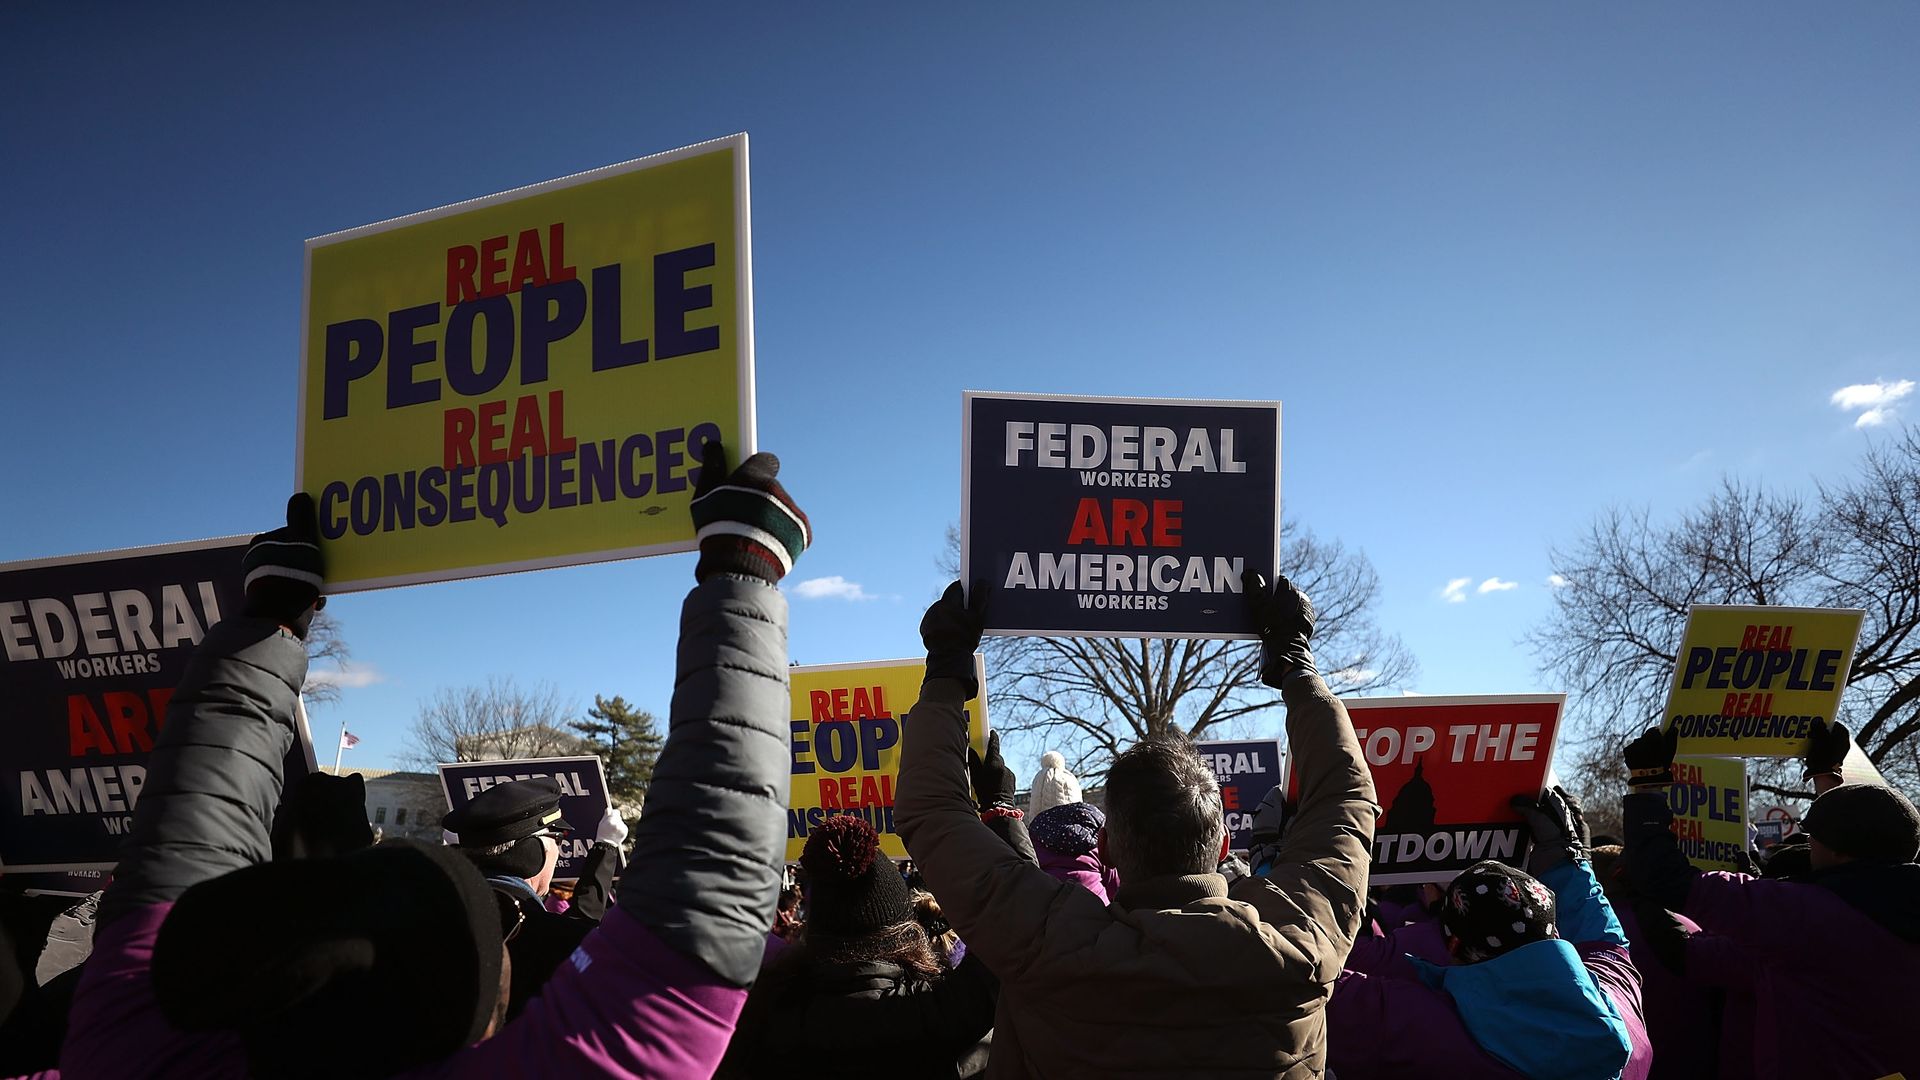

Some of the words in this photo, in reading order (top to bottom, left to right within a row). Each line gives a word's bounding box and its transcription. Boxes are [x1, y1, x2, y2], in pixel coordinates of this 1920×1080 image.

[447, 222, 577, 307] REAL
[323, 242, 720, 420] PEOPLE
[443, 390, 576, 471] REAL
[1005, 421, 1247, 473] FEDERAL
[319, 422, 722, 540] CONSEQUENCES
[1080, 471, 1172, 488] WORKERS
[1067, 497, 1183, 547] ARE
[1004, 552, 1245, 593] AMERICAN
[1077, 594, 1169, 610] WORKERS
[1740, 625, 1793, 650] REAL
[56, 652, 161, 680] WORKERS
[1681, 647, 1842, 691] PEOPLE
[810, 686, 891, 724] REAL
[1721, 692, 1774, 718] REAL
[1449, 723, 1542, 763] THE
[819, 775, 895, 810] REAL
[1671, 763, 1706, 787] REAL
[1664, 784, 1741, 823] OPLE
[1376, 828, 1520, 864] TDOWN
